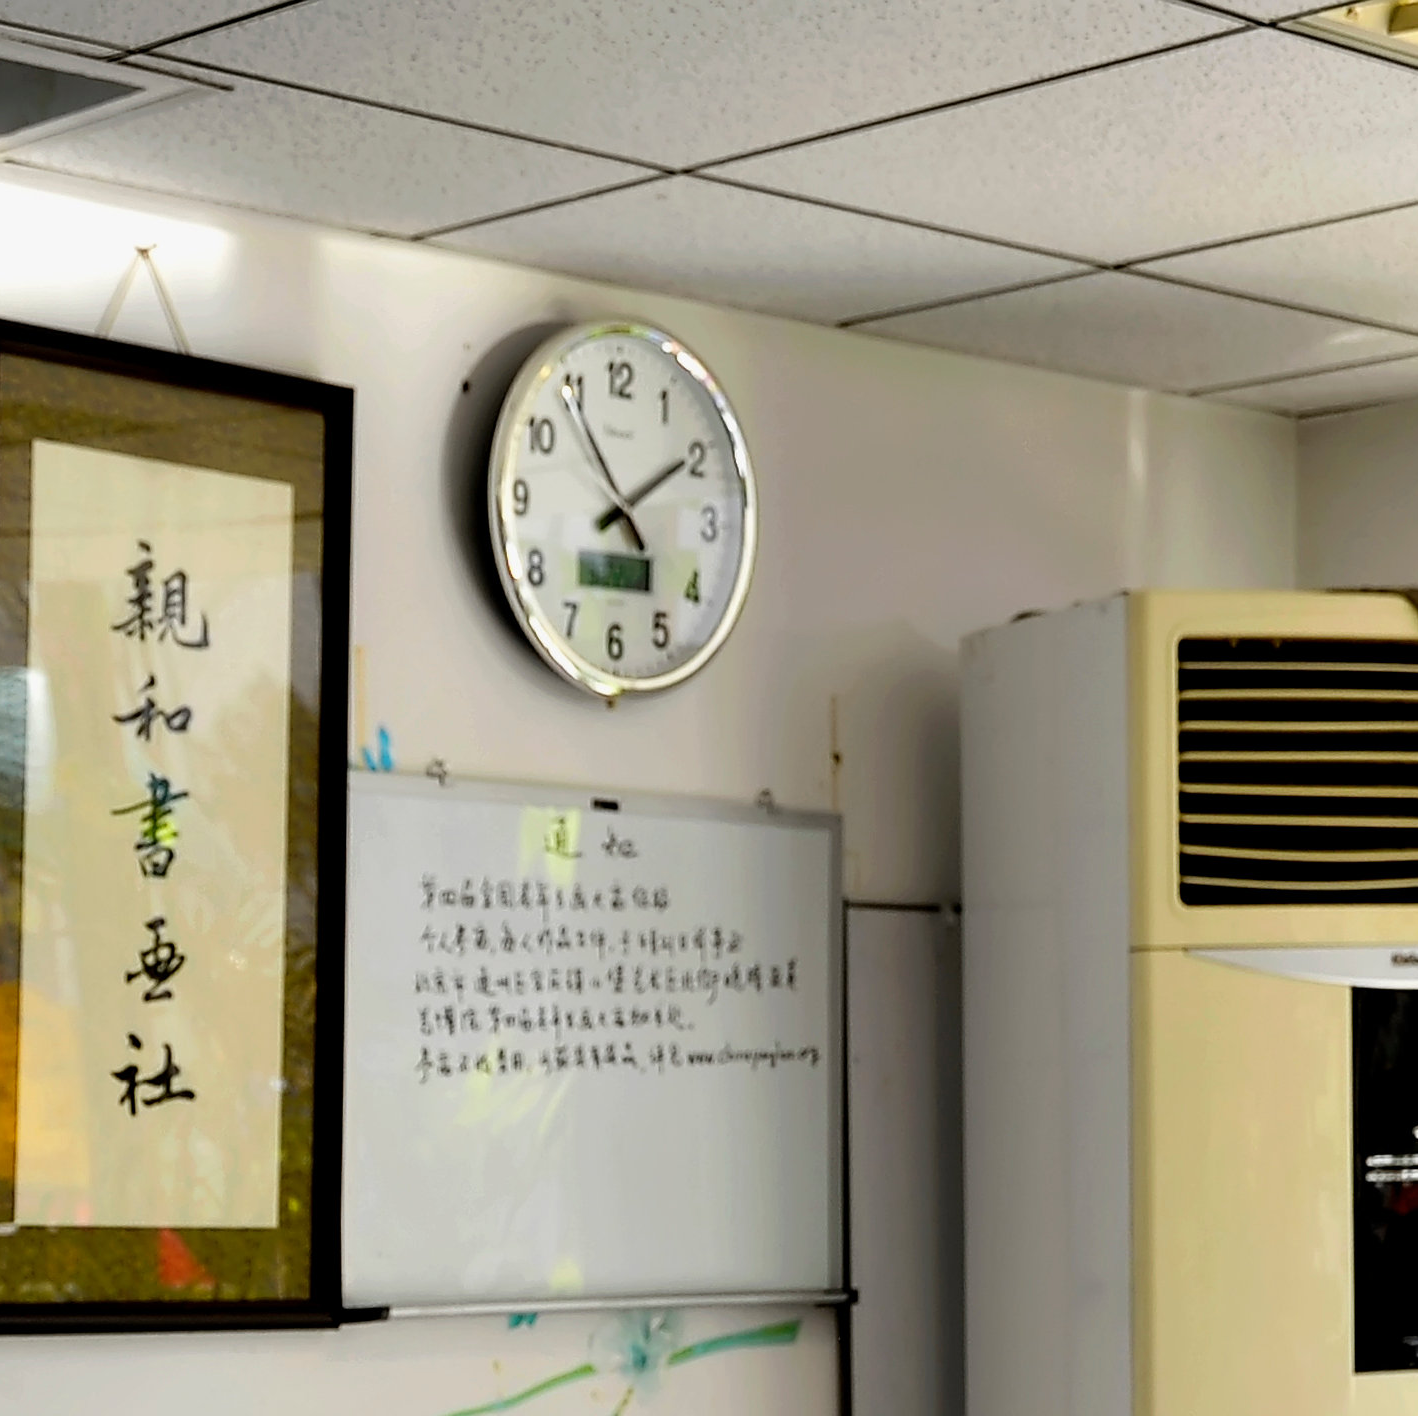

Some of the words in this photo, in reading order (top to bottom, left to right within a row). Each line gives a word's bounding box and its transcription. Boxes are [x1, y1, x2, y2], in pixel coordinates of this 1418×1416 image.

[608, 361, 633, 400] 12
[661, 390, 670, 425] 1
[528, 418, 555, 455] 10
[687, 440, 705, 477] 2
[513, 479, 529, 515] 9
[700, 506, 719, 542] 3
[527, 551, 544, 587] 8
[684, 569, 700, 604] 4
[563, 602, 578, 639] 7
[652, 612, 670, 649] 5
[606, 625, 624, 661] 6
